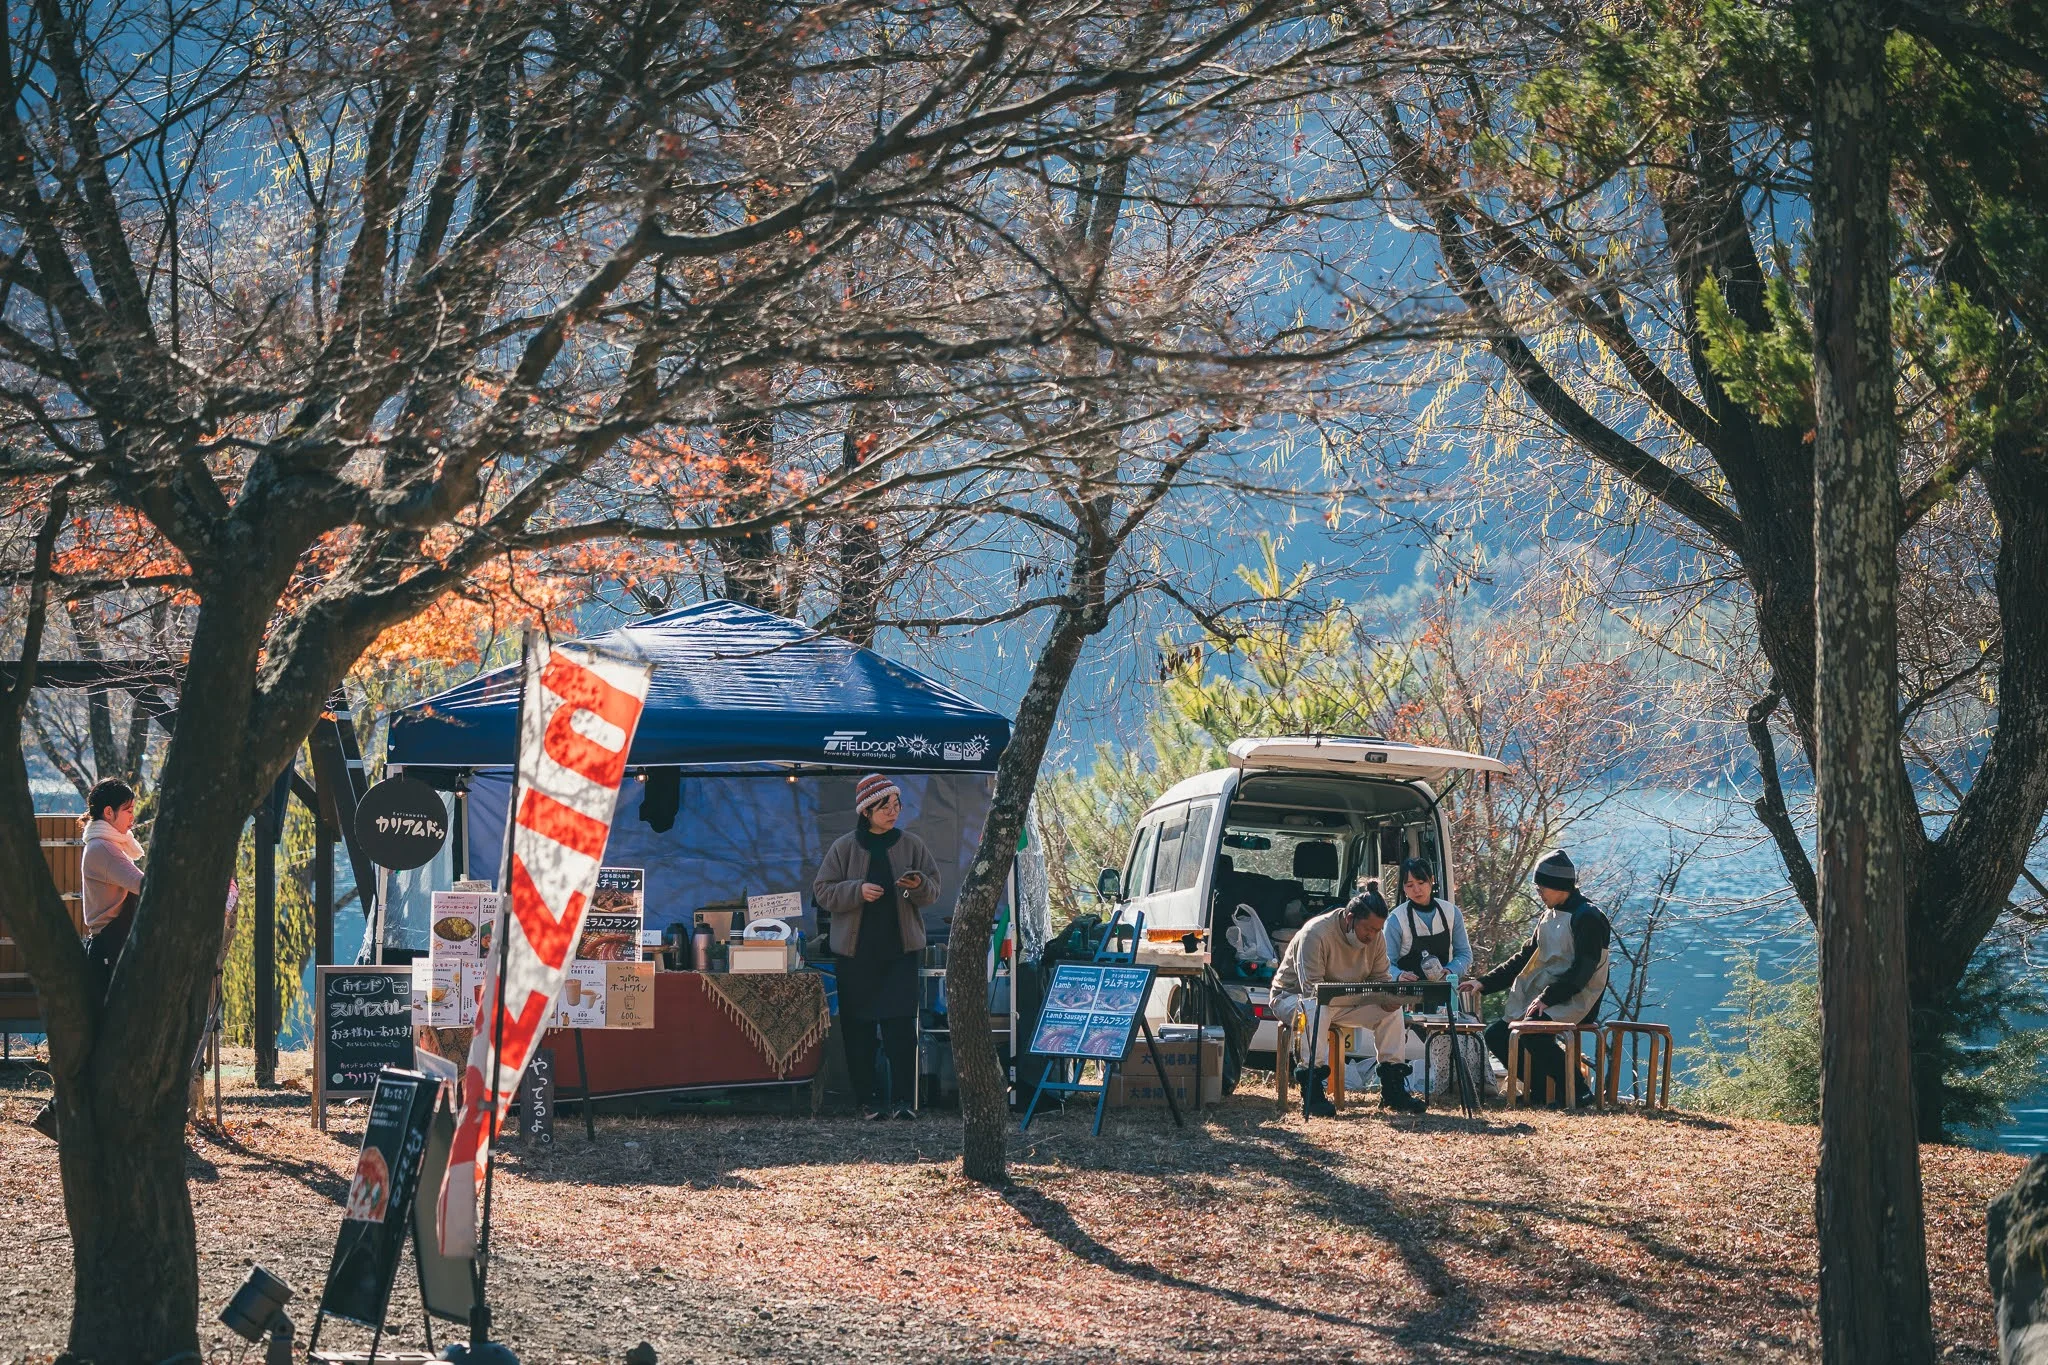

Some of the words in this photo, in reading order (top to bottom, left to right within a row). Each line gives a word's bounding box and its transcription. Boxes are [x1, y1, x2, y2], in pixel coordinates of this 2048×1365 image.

[839, 741, 896, 752] FIELDOOR
[375, 815, 445, 840] カリアムドゥ
[342, 979, 382, 992] 南インド
[1054, 981, 1072, 989] Lamb
[1080, 983, 1096, 991] Chop
[1104, 979, 1144, 989] ラムチョップ
[330, 997, 412, 1018] スパイスカレー
[1063, 1013, 1087, 1021] Sausage
[1091, 1015, 1132, 1025] 生ラムフランク
[344, 1071, 380, 1085] カリア
[528, 1057, 551, 1143] やってるよ。
